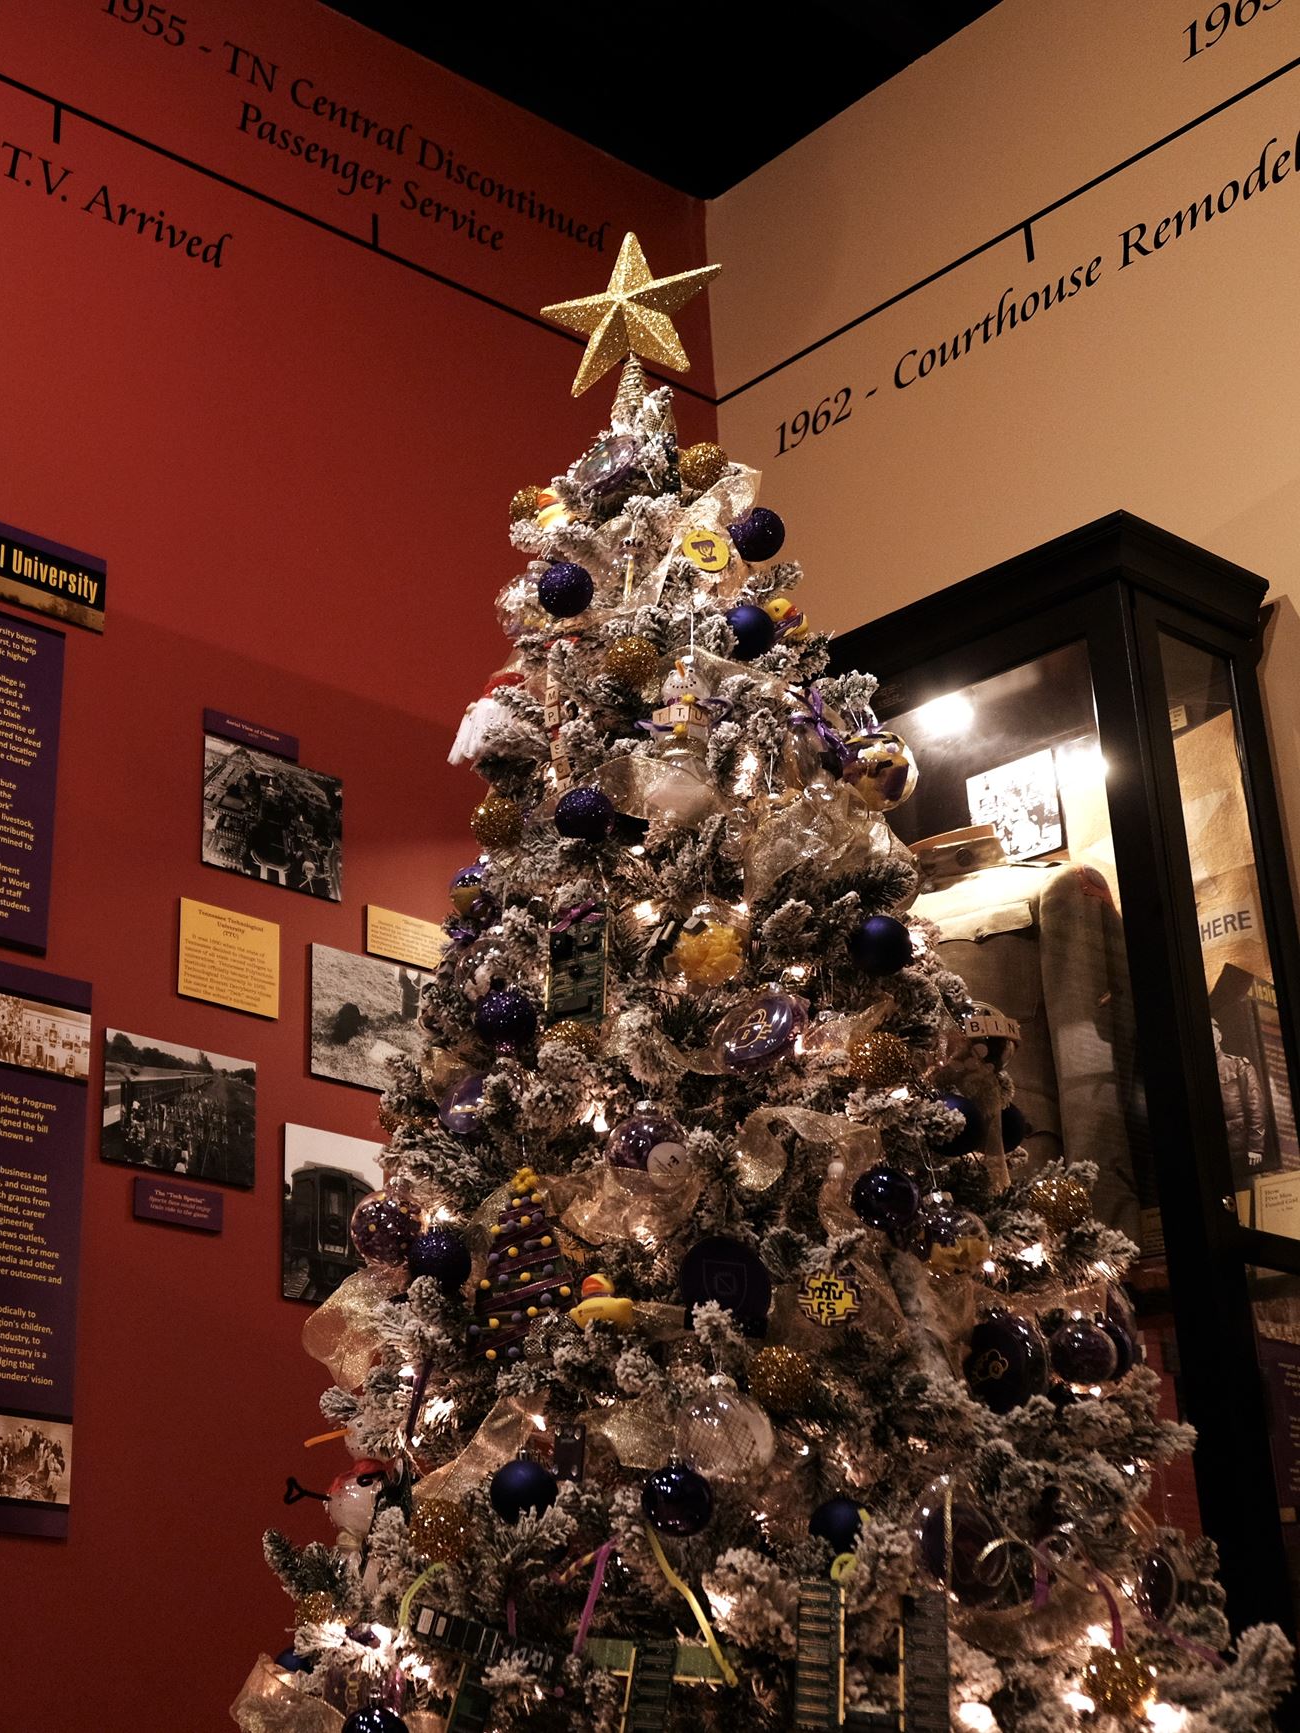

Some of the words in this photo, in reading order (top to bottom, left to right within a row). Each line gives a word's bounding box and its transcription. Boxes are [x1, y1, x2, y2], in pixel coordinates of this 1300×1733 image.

[1182, 0, 1282, 63] 196
[101, 0, 187, 47] 1955
[223, 41, 279, 93] TN
[290, 79, 412, 155] Central
[416, 136, 611, 253] Discontinued
[235, 101, 391, 196] Passenger
[400, 181, 505, 253] Service
[1, 141, 73, 202] T.V.
[81, 185, 233, 268] Arrived
[774, 387, 852, 458] 1962
[894, 255, 1102, 390] Courthouse
[12, 548, 98, 605] University
[15, 631, 37, 645] began
[241, 724, 253, 732] View
[198, 909, 226, 921] Tennessee
[217, 921, 245, 934] University
[1201, 910, 1252, 942] HERE
[22, 1096, 57, 1112] Programs
[0, 1165, 32, 1179] business
[32, 1173, 48, 1183] and
[27, 1310, 37, 1319] to
